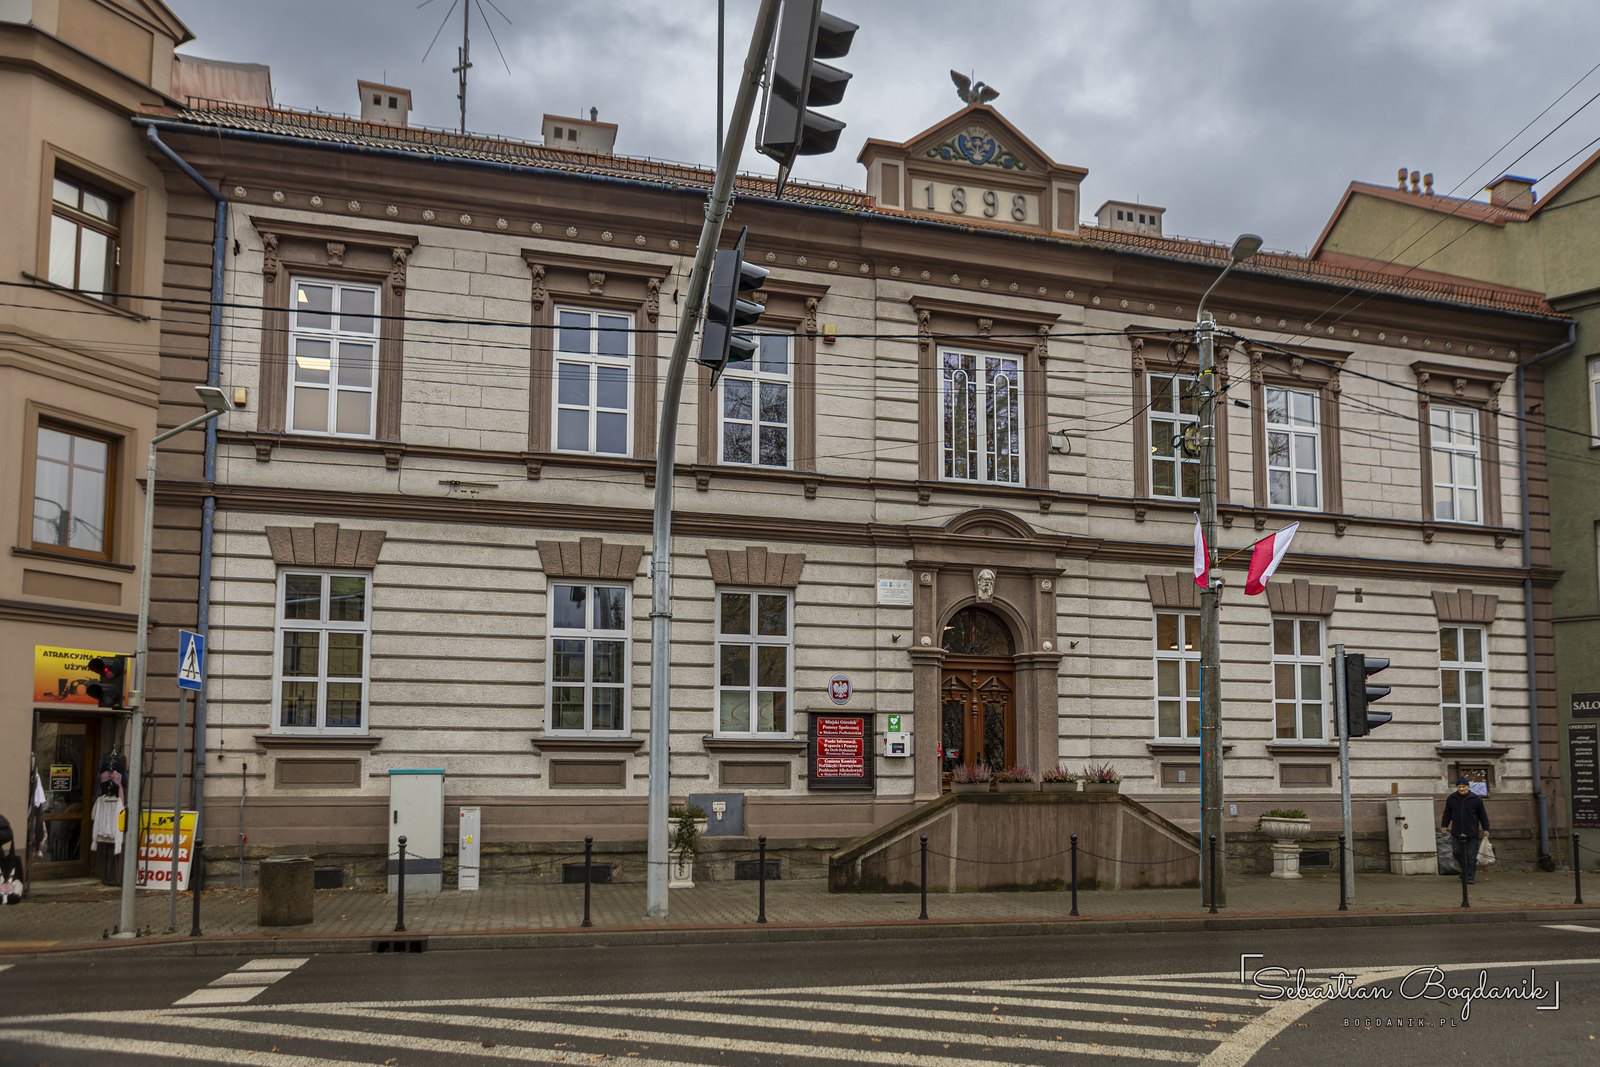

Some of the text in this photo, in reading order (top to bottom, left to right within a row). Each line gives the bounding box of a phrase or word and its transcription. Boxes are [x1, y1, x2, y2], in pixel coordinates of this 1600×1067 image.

[924, 181, 1027, 221] 1898
[42, 650, 94, 660] ATRAKCYJNA
[138, 868, 182, 882] ŚRODA
